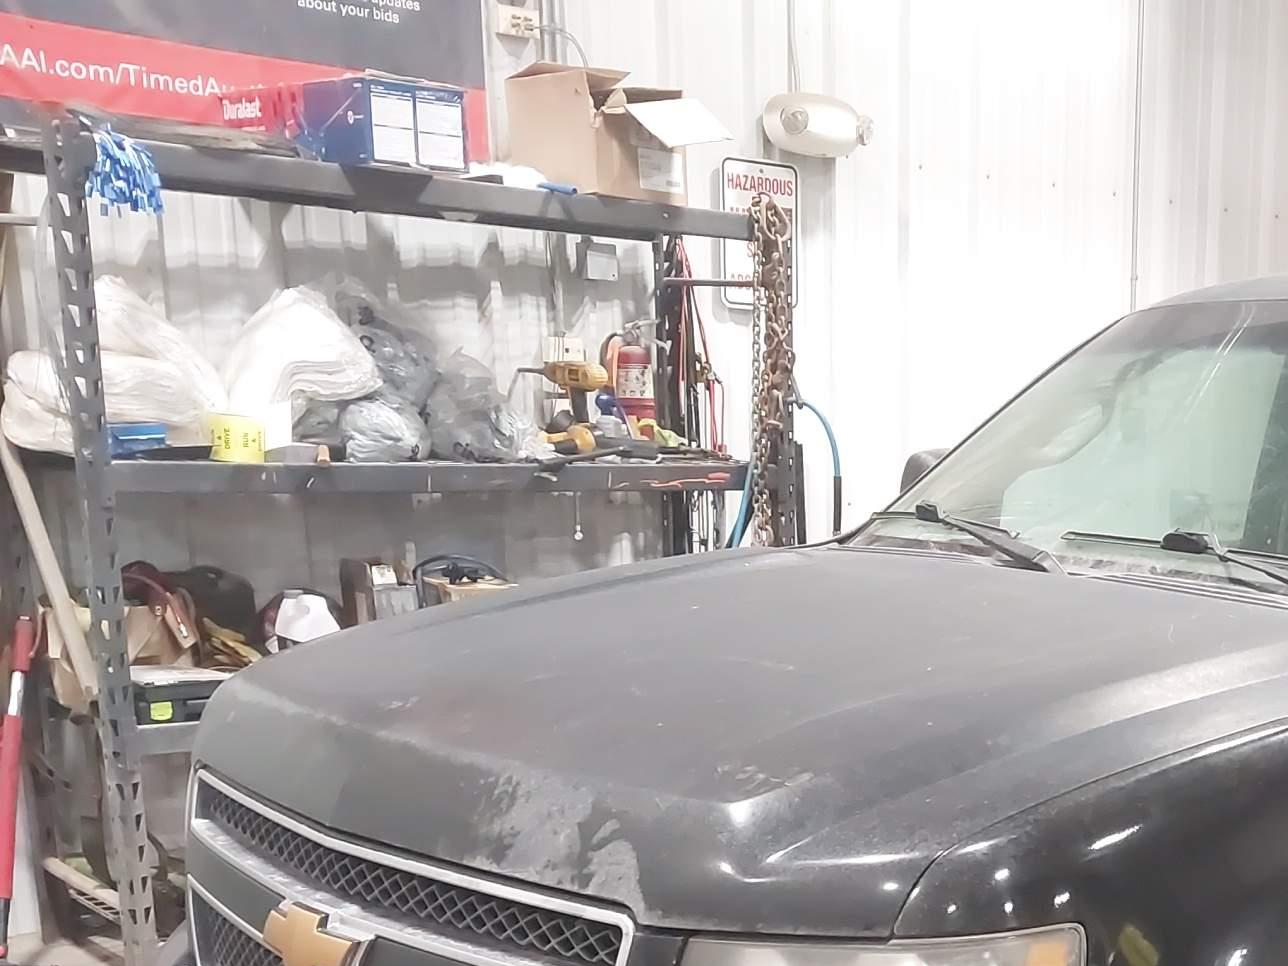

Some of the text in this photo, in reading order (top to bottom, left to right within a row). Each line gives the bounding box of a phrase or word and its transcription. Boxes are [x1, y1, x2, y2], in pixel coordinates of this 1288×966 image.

[297, 0, 400, 24] about your bids
[0, 43, 262, 97] AAI.com/TimedA
[222, 95, 263, 121] Duralast
[727, 172, 793, 197] HAZARDOUS
